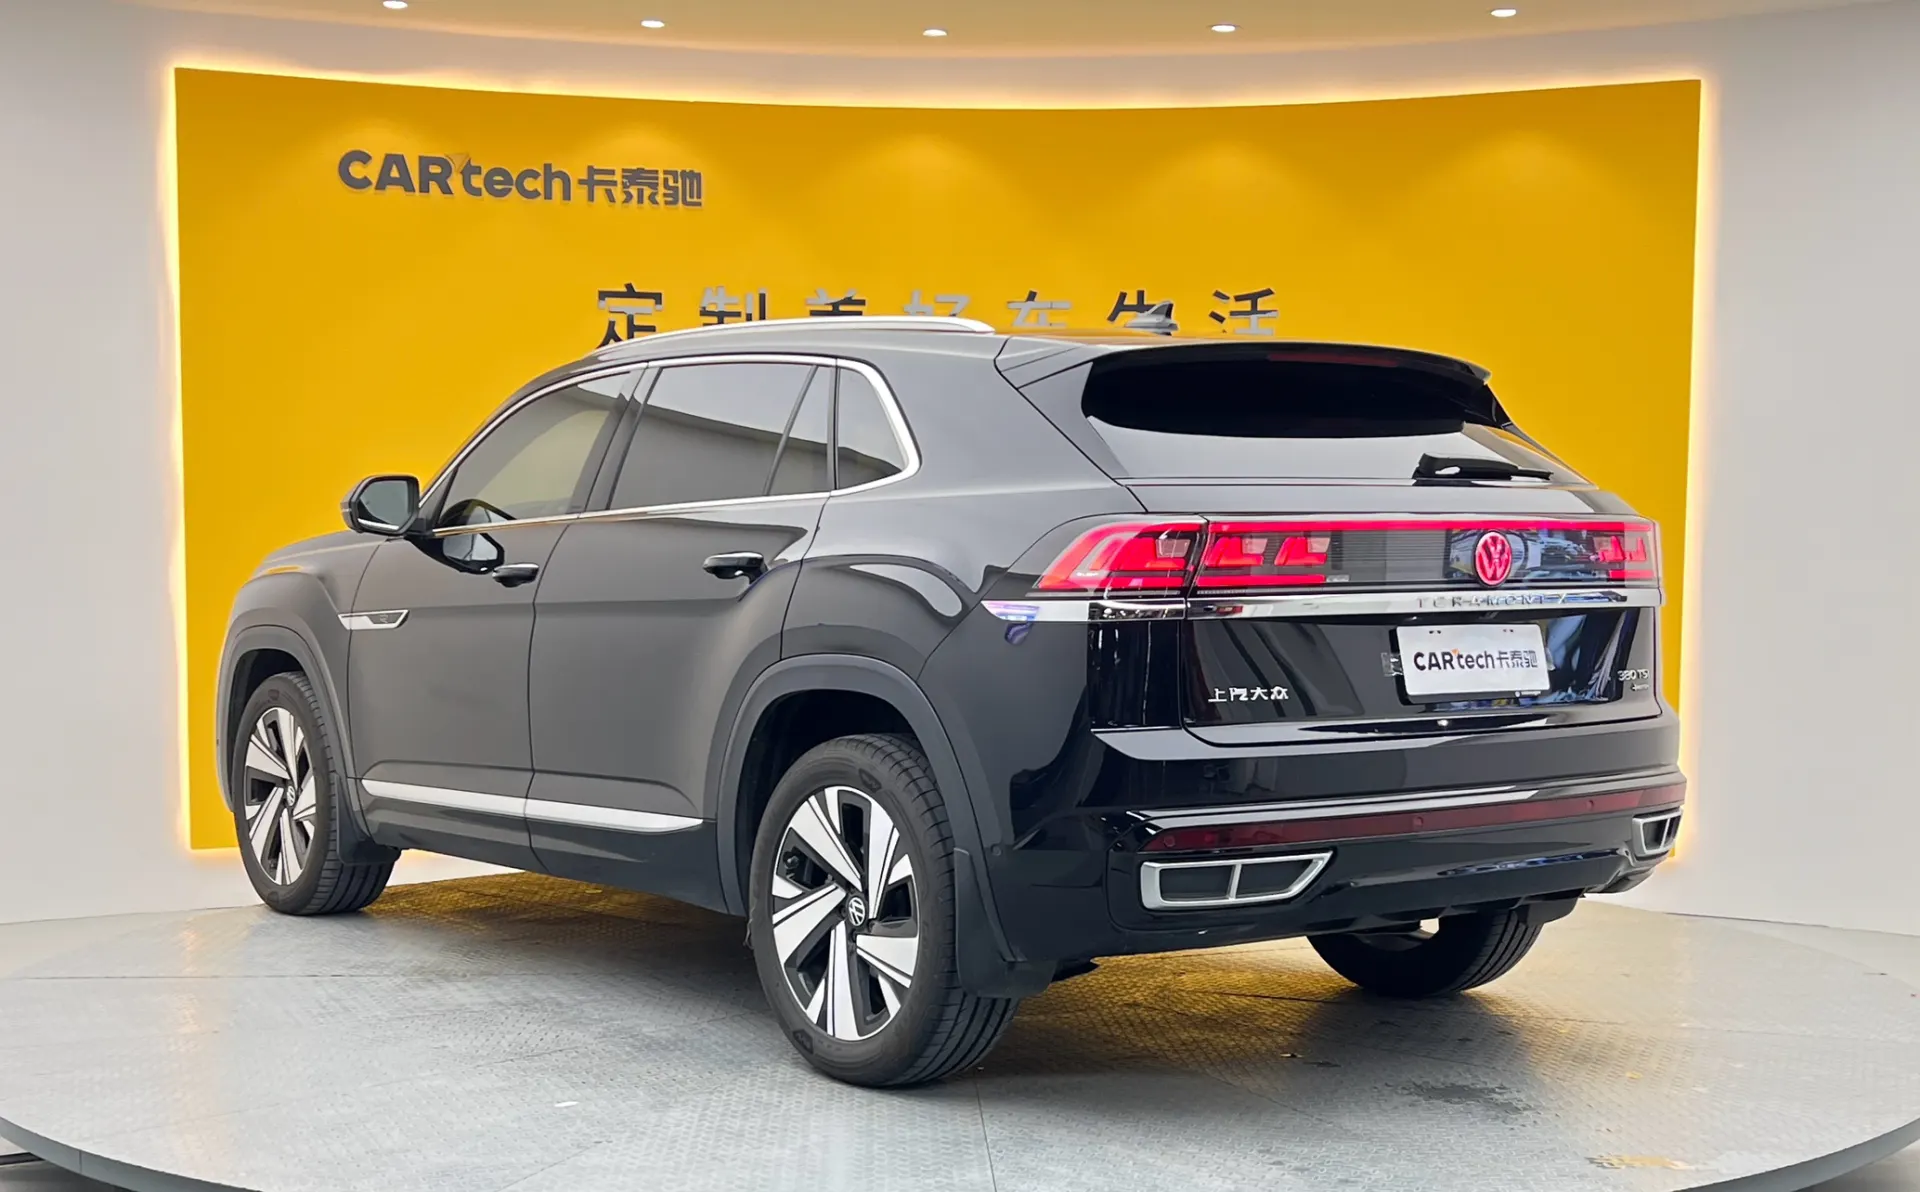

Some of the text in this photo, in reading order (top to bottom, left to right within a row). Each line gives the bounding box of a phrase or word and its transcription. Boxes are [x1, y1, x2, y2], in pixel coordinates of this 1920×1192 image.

[338, 150, 702, 206] CARtech 卡泰驰
[1413, 650, 1538, 671] CARtech 卡泰驰
